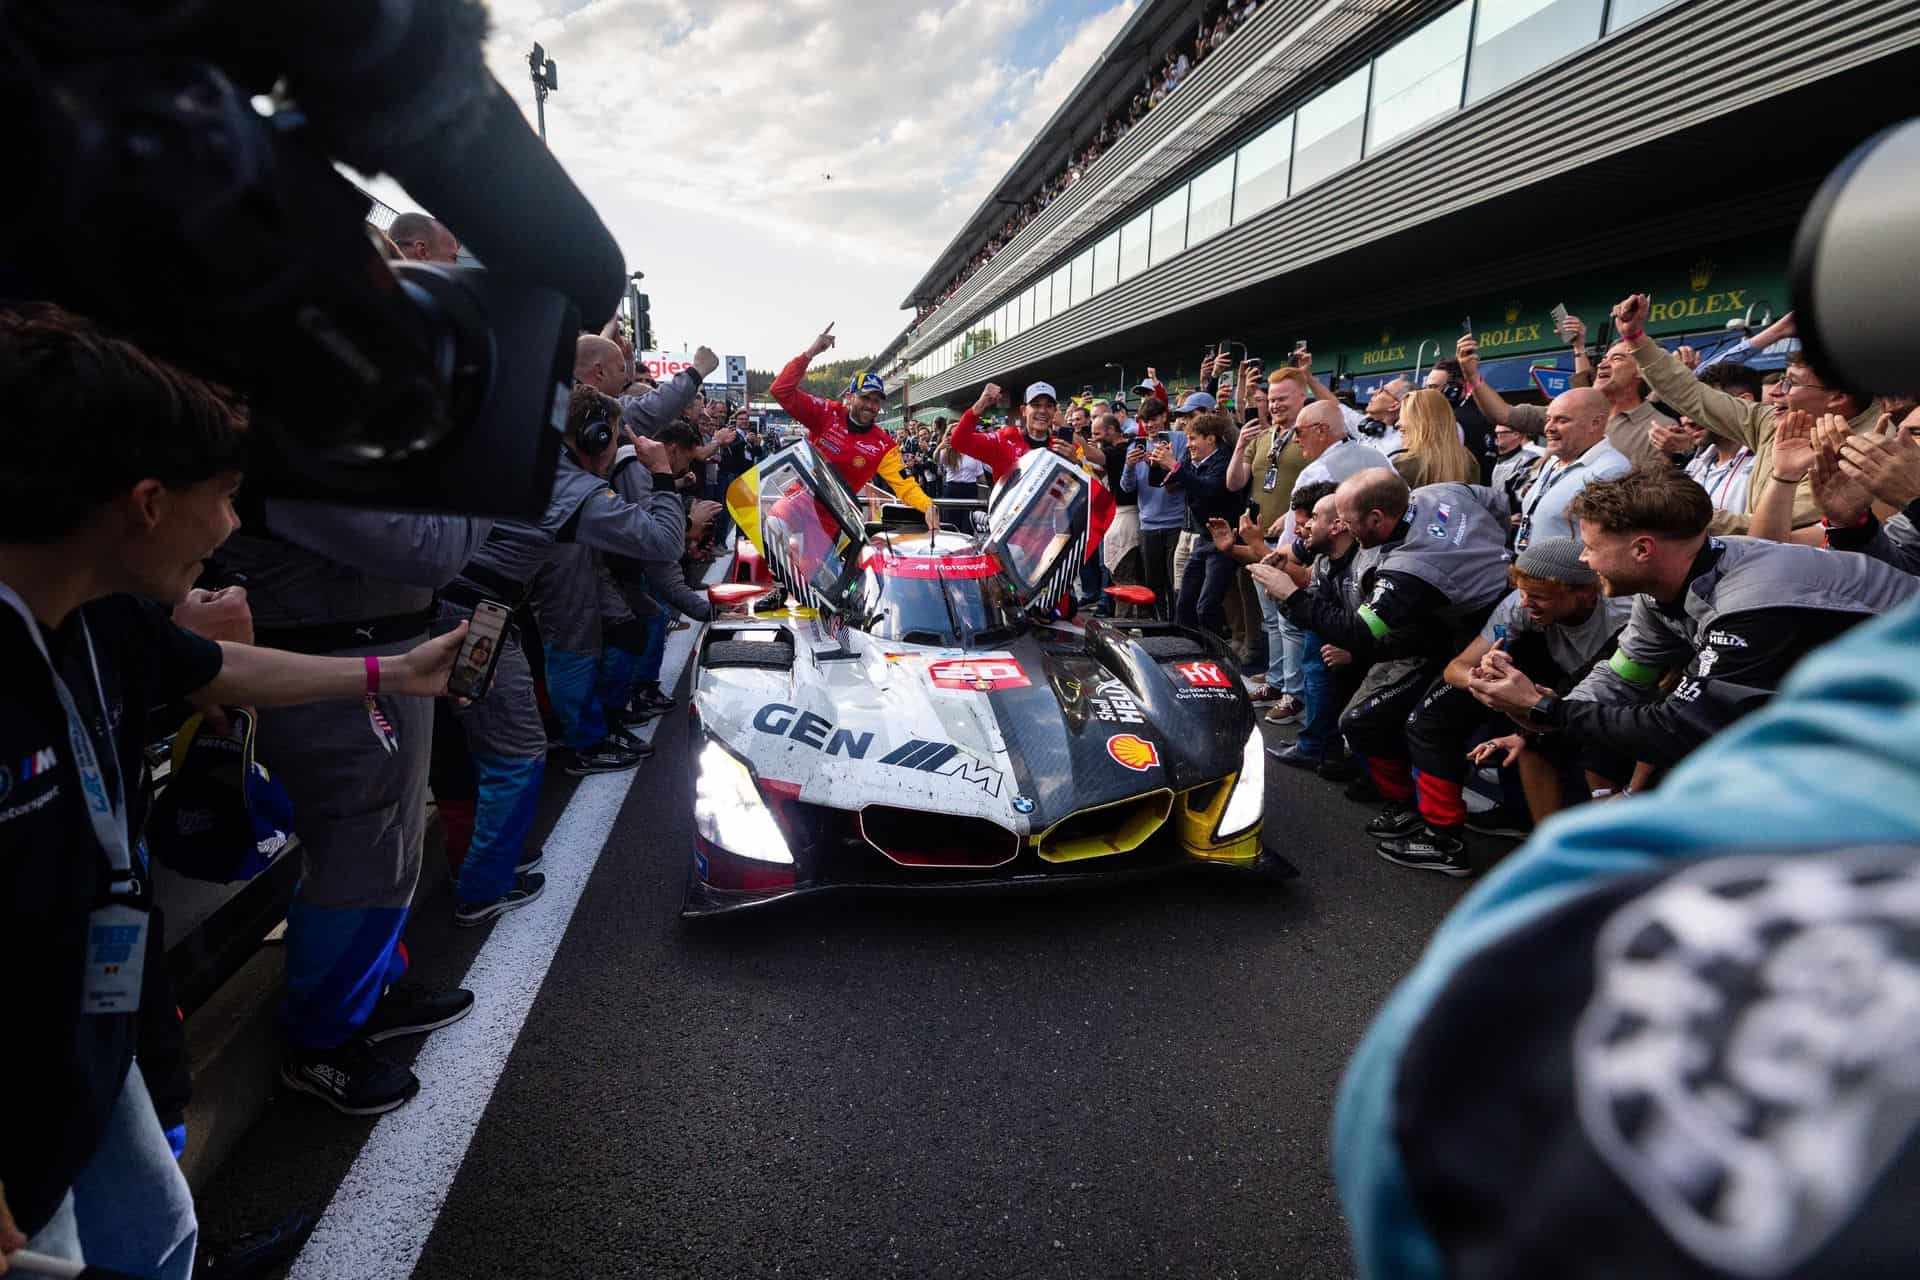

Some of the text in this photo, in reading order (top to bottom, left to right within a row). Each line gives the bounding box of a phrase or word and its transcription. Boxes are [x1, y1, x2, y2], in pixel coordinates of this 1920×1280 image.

[1648, 289, 1747, 323] ROLEX
[1479, 323, 1541, 348] ROLEX
[1362, 345, 1406, 365] ROLEX
[1547, 377, 1566, 389] 15
[1709, 636, 1748, 648] HELIX
[1179, 665, 1222, 682] HY
[1090, 698, 1117, 722] Shell
[1096, 677, 1144, 724] HELIX
[752, 702, 875, 760] GEN
